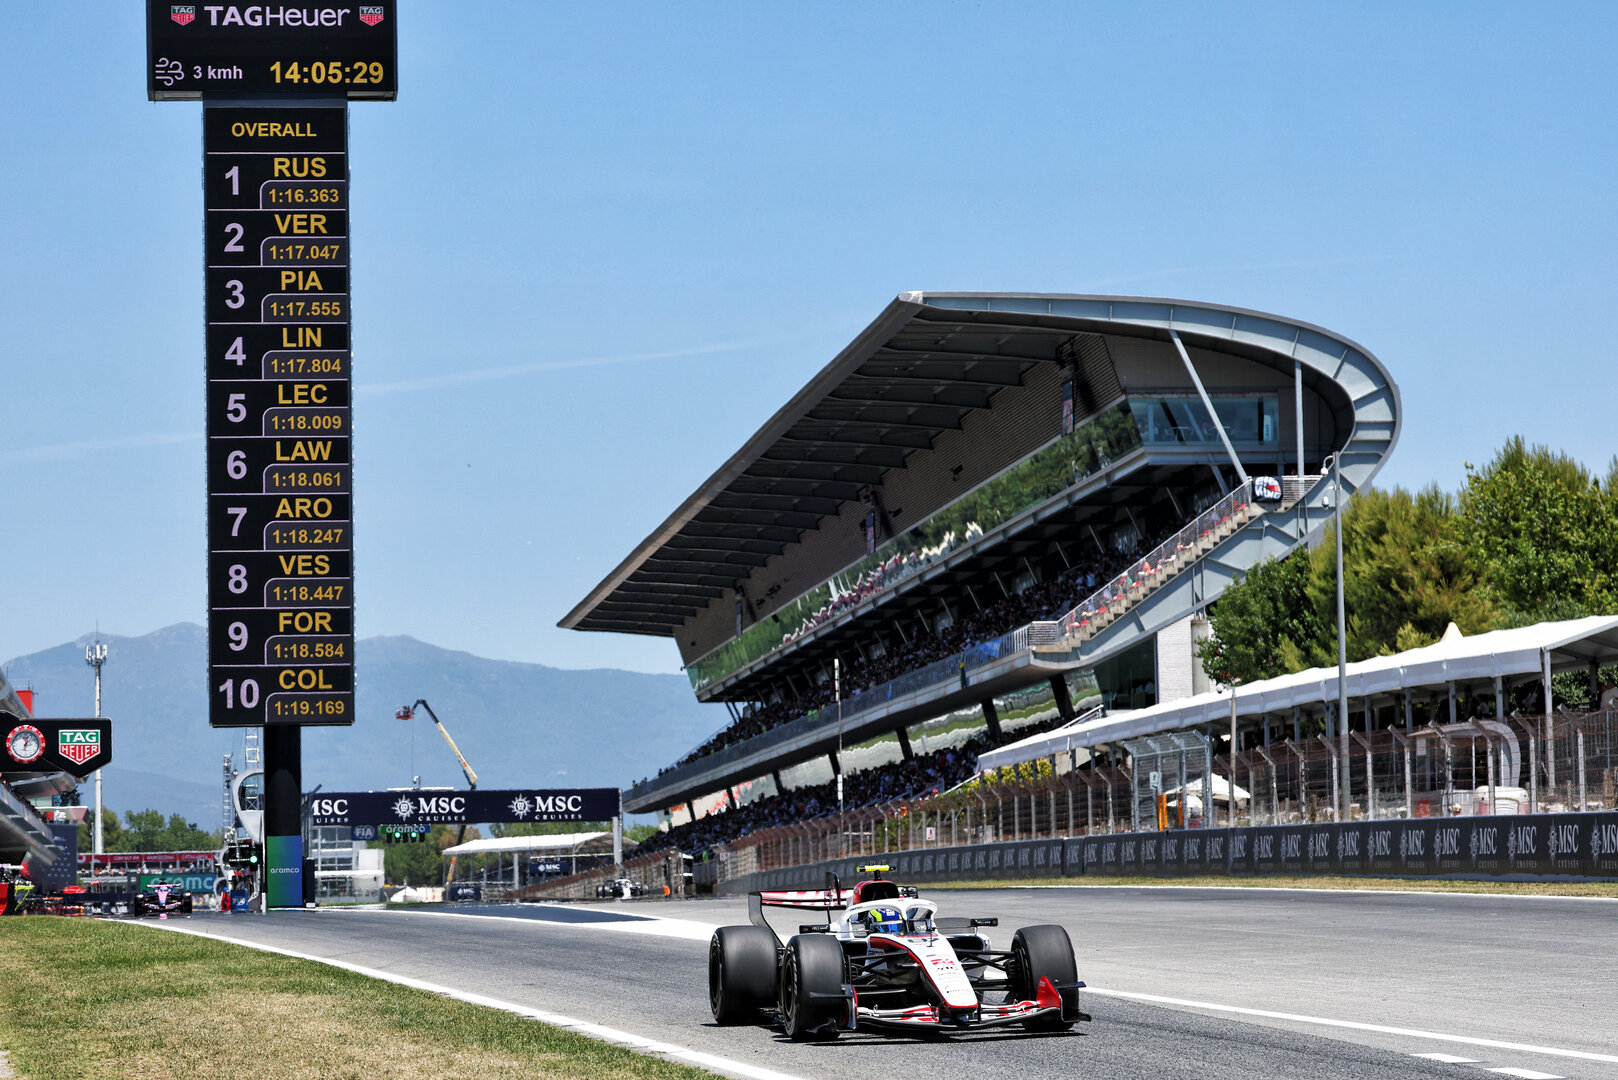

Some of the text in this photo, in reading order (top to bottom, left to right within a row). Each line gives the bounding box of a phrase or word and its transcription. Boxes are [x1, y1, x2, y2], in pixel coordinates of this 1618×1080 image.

[172, 15, 194, 25] HEUER
[360, 15, 382, 25] HEUER
[193, 65, 243, 79] 3 kmh
[269, 61, 384, 84] 14:05:29
[231, 122, 317, 137] OVERALL
[273, 158, 327, 177] RUS
[226, 166, 239, 195] 1
[269, 188, 339, 202] 1:16.363
[274, 214, 328, 233] VER
[224, 223, 244, 252] 2
[269, 245, 340, 259] 1:17.047
[280, 271, 323, 290] PIA
[226, 280, 244, 309] 3
[270, 301, 341, 316] 1:17.555
[282, 328, 322, 347] LIN
[225, 337, 246, 365] 4
[271, 358, 342, 372] 1:17.804
[278, 384, 328, 404] LEC
[227, 394, 246, 422] 5
[271, 415, 342, 429] 1:18.009
[275, 441, 332, 460] LAW
[227, 451, 247, 479] 6
[272, 471, 341, 486] 1:18.061
[274, 498, 333, 517] ARO
[228, 508, 247, 536] 7
[272, 528, 343, 543] 1:18.247
[278, 555, 330, 574] VES
[229, 565, 248, 594] 8
[273, 585, 344, 600] 1:18.447
[278, 612, 333, 632] FOR
[229, 622, 248, 651] 9
[273, 643, 345, 657] 1:18.584
[278, 670, 333, 689] COL
[219, 678, 260, 709] 10
[274, 700, 345, 715] 1:19.169
[62, 732, 97, 743] TAG
[61, 745, 98, 762] HEUER
[418, 797, 466, 814] MSC
[534, 795, 582, 813] MSC
[355, 827, 373, 837] FIA
[385, 825, 426, 834] aramco
[1558, 824, 1579, 854] MSC
[1286, 834, 1301, 858] MSC
[1314, 832, 1330, 857] MSC
[1344, 831, 1360, 856] MSC
[1374, 830, 1392, 856] MSC
[1408, 830, 1425, 856] MSC
[1442, 828, 1460, 855] MSC
[1478, 827, 1498, 855] MSC
[1517, 825, 1538, 854] MSC
